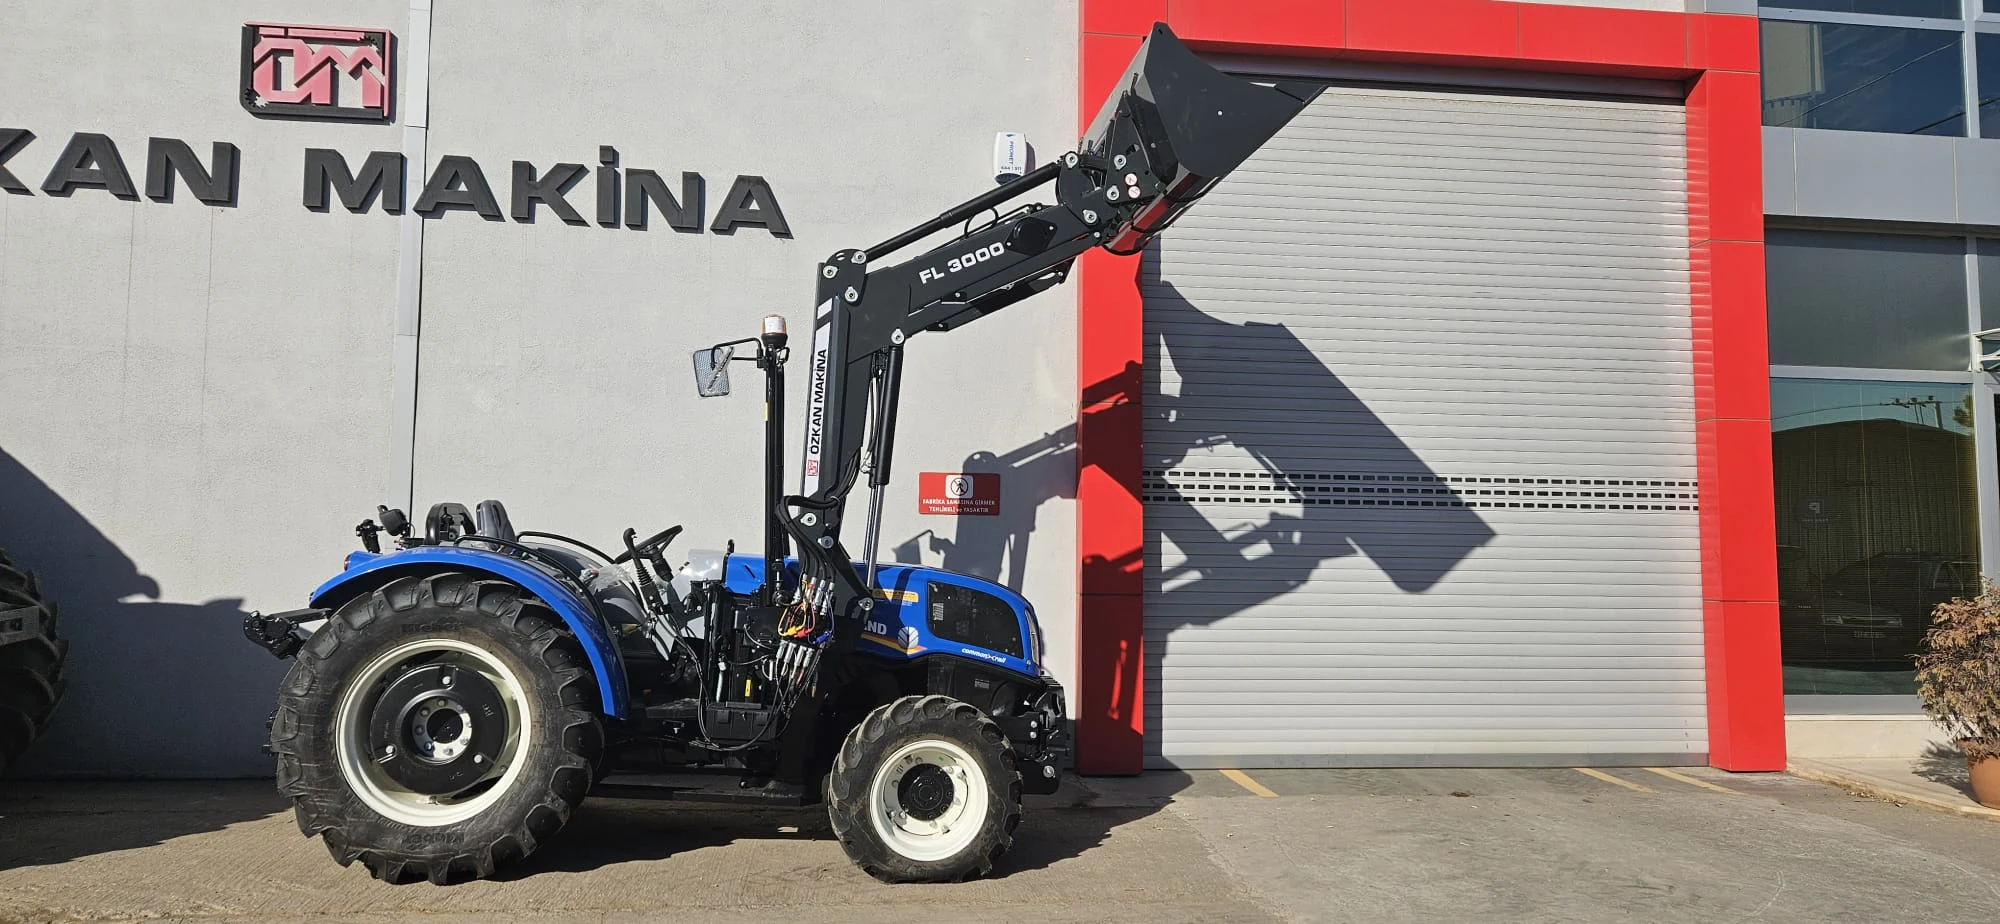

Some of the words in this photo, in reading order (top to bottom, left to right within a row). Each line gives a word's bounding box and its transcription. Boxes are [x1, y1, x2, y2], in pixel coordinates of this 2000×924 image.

[302, 145, 794, 239] MAKİNA
[919, 266, 945, 285] FL
[947, 242, 1005, 273] 3000
[813, 349, 827, 403] MAKİNA
[808, 406, 822, 455] ÖZKAN
[864, 620, 887, 635] ND
